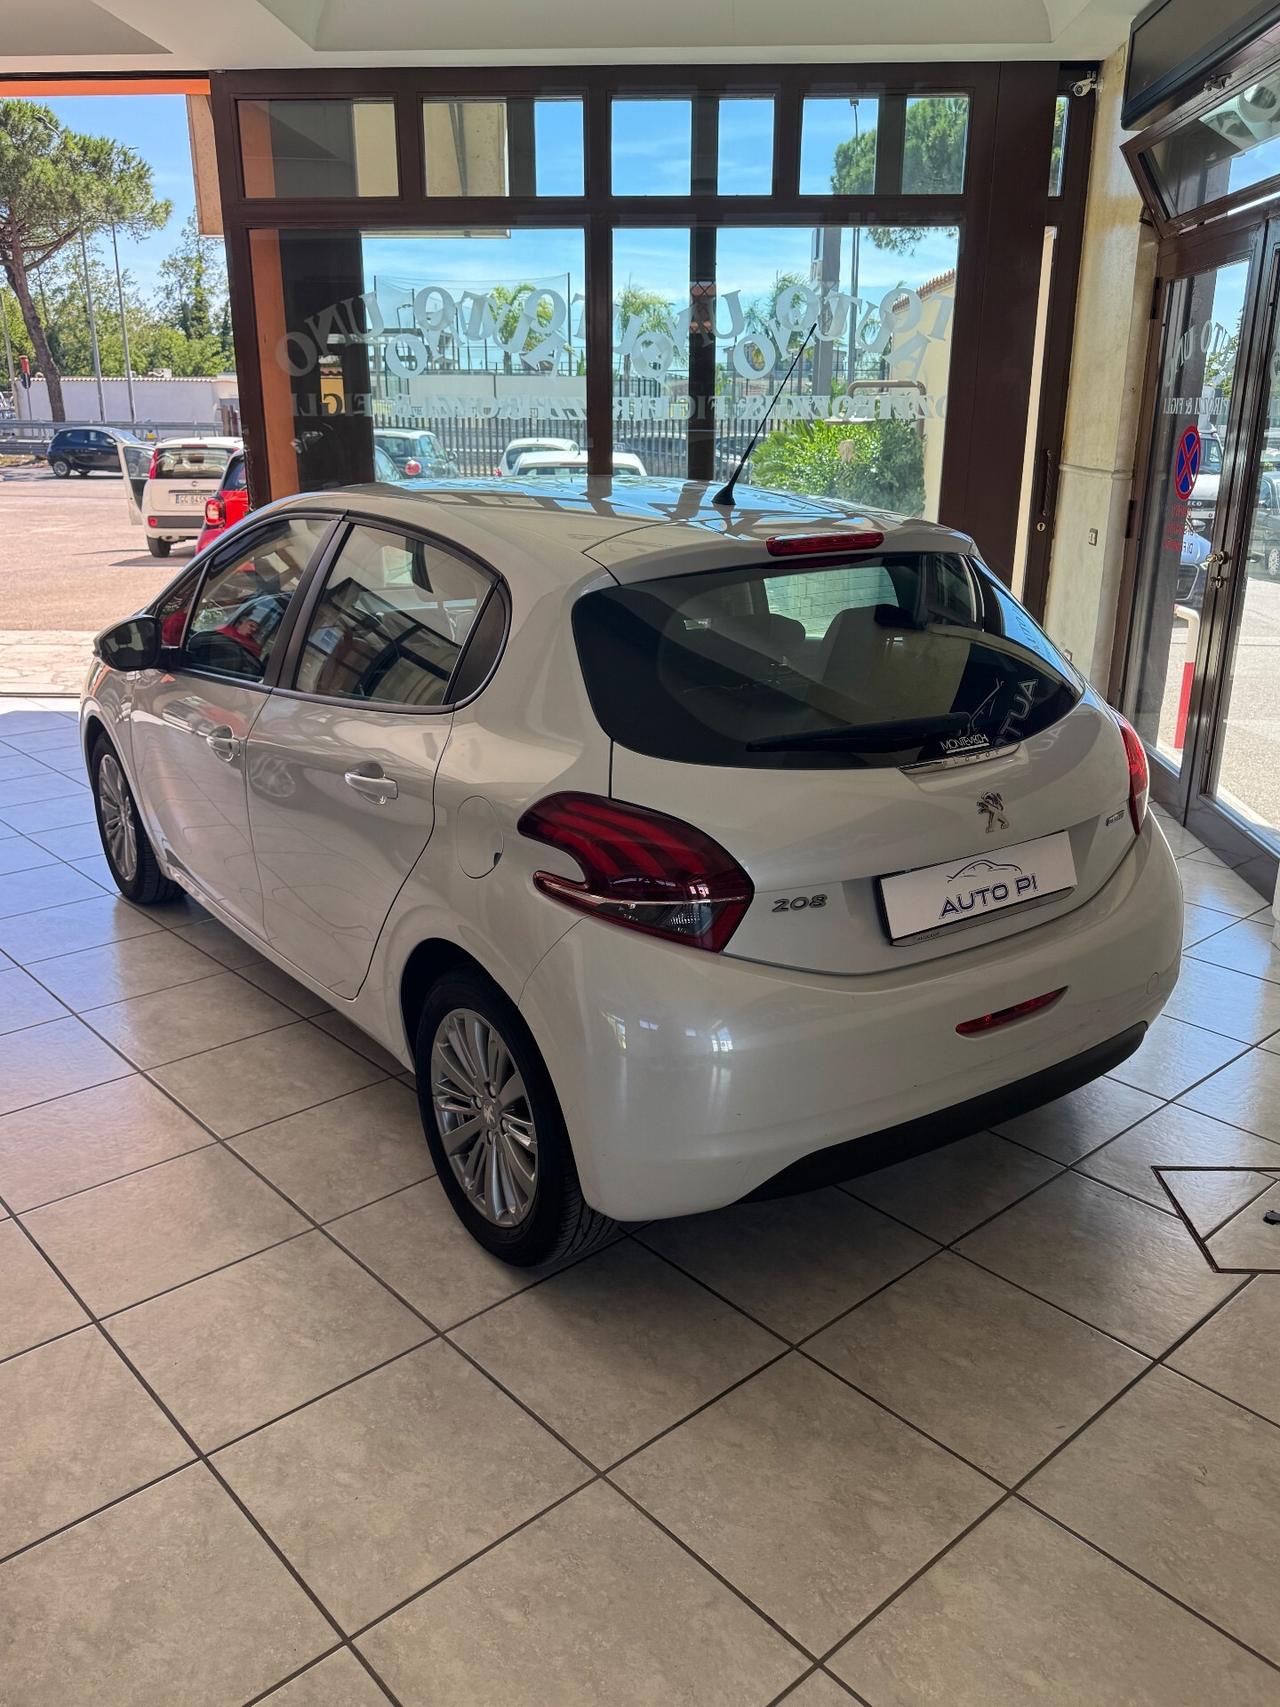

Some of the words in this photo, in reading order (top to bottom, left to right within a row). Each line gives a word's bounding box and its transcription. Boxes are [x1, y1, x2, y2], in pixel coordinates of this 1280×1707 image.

[771, 893, 829, 913] 208
[939, 883, 1009, 919] AUTO
[1016, 873, 1039, 897] PI
